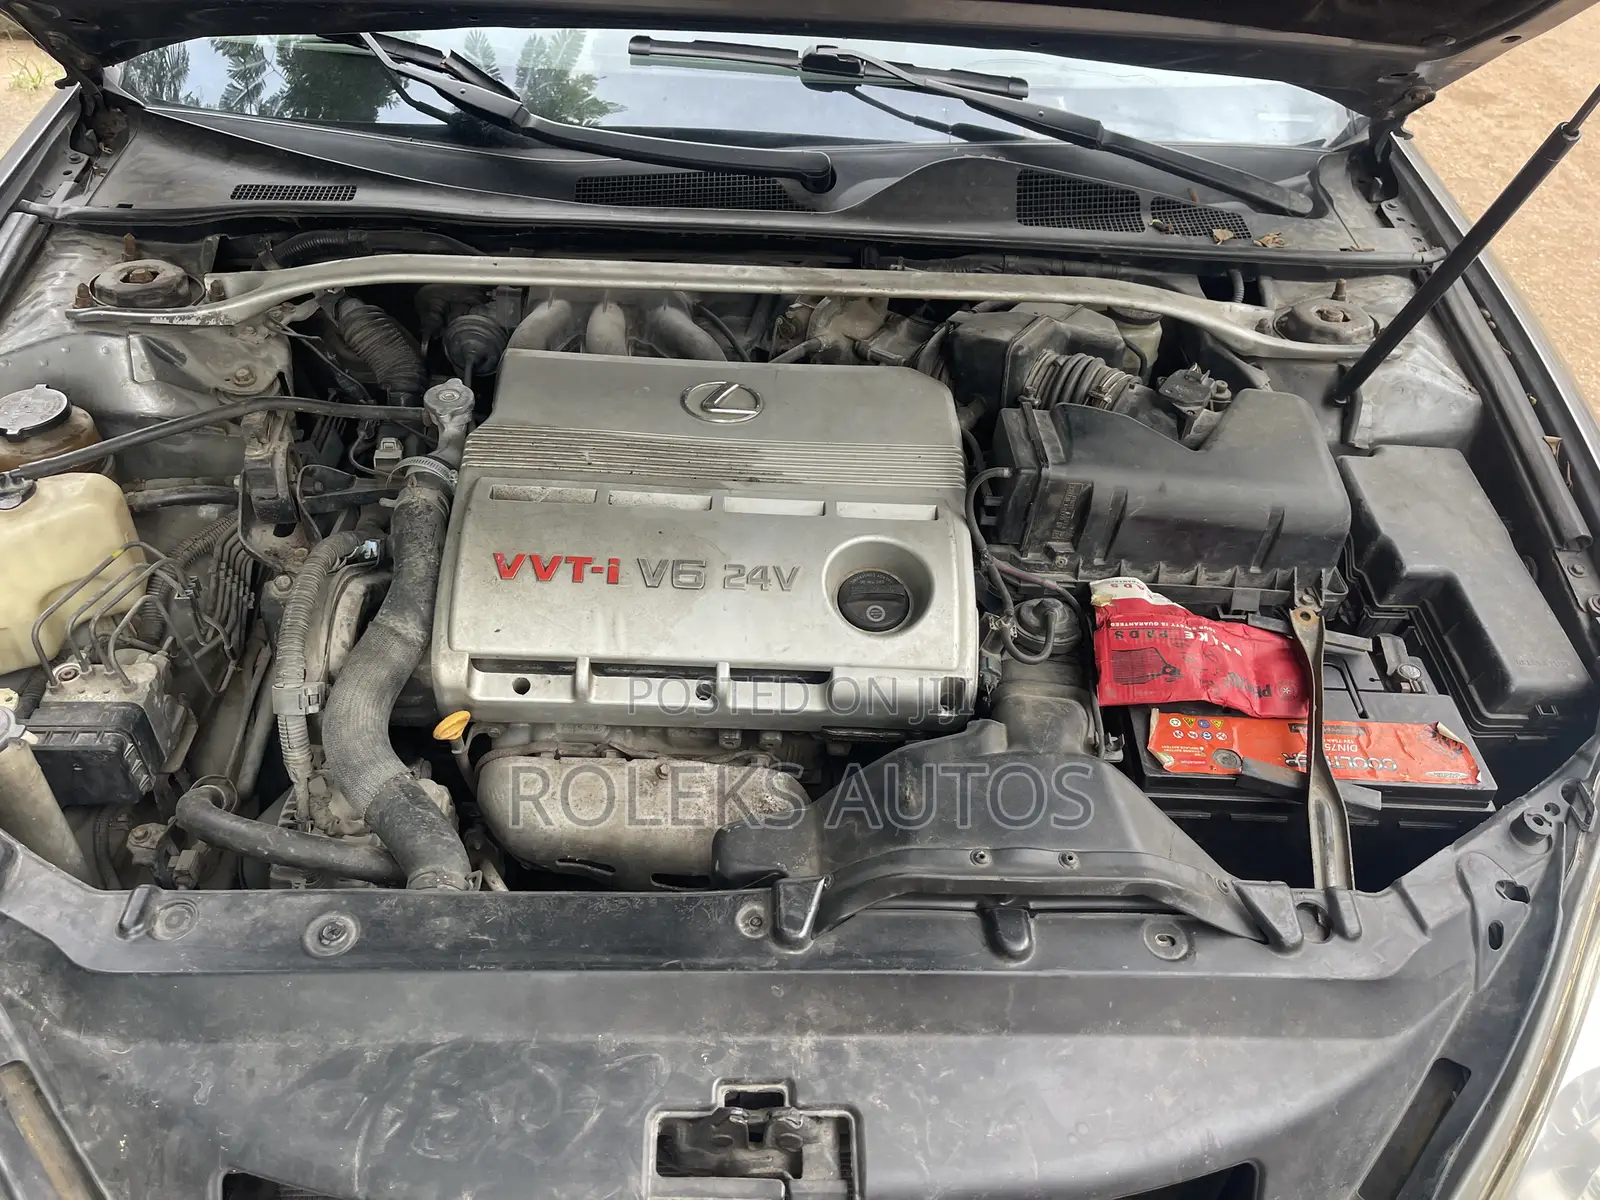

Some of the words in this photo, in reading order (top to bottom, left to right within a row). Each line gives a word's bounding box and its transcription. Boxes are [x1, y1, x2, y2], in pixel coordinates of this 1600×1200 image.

[493, 552, 621, 585] VVT-i
[637, 557, 707, 590] V6
[723, 563, 801, 591] 24V
[1114, 630, 1168, 640] PADS
